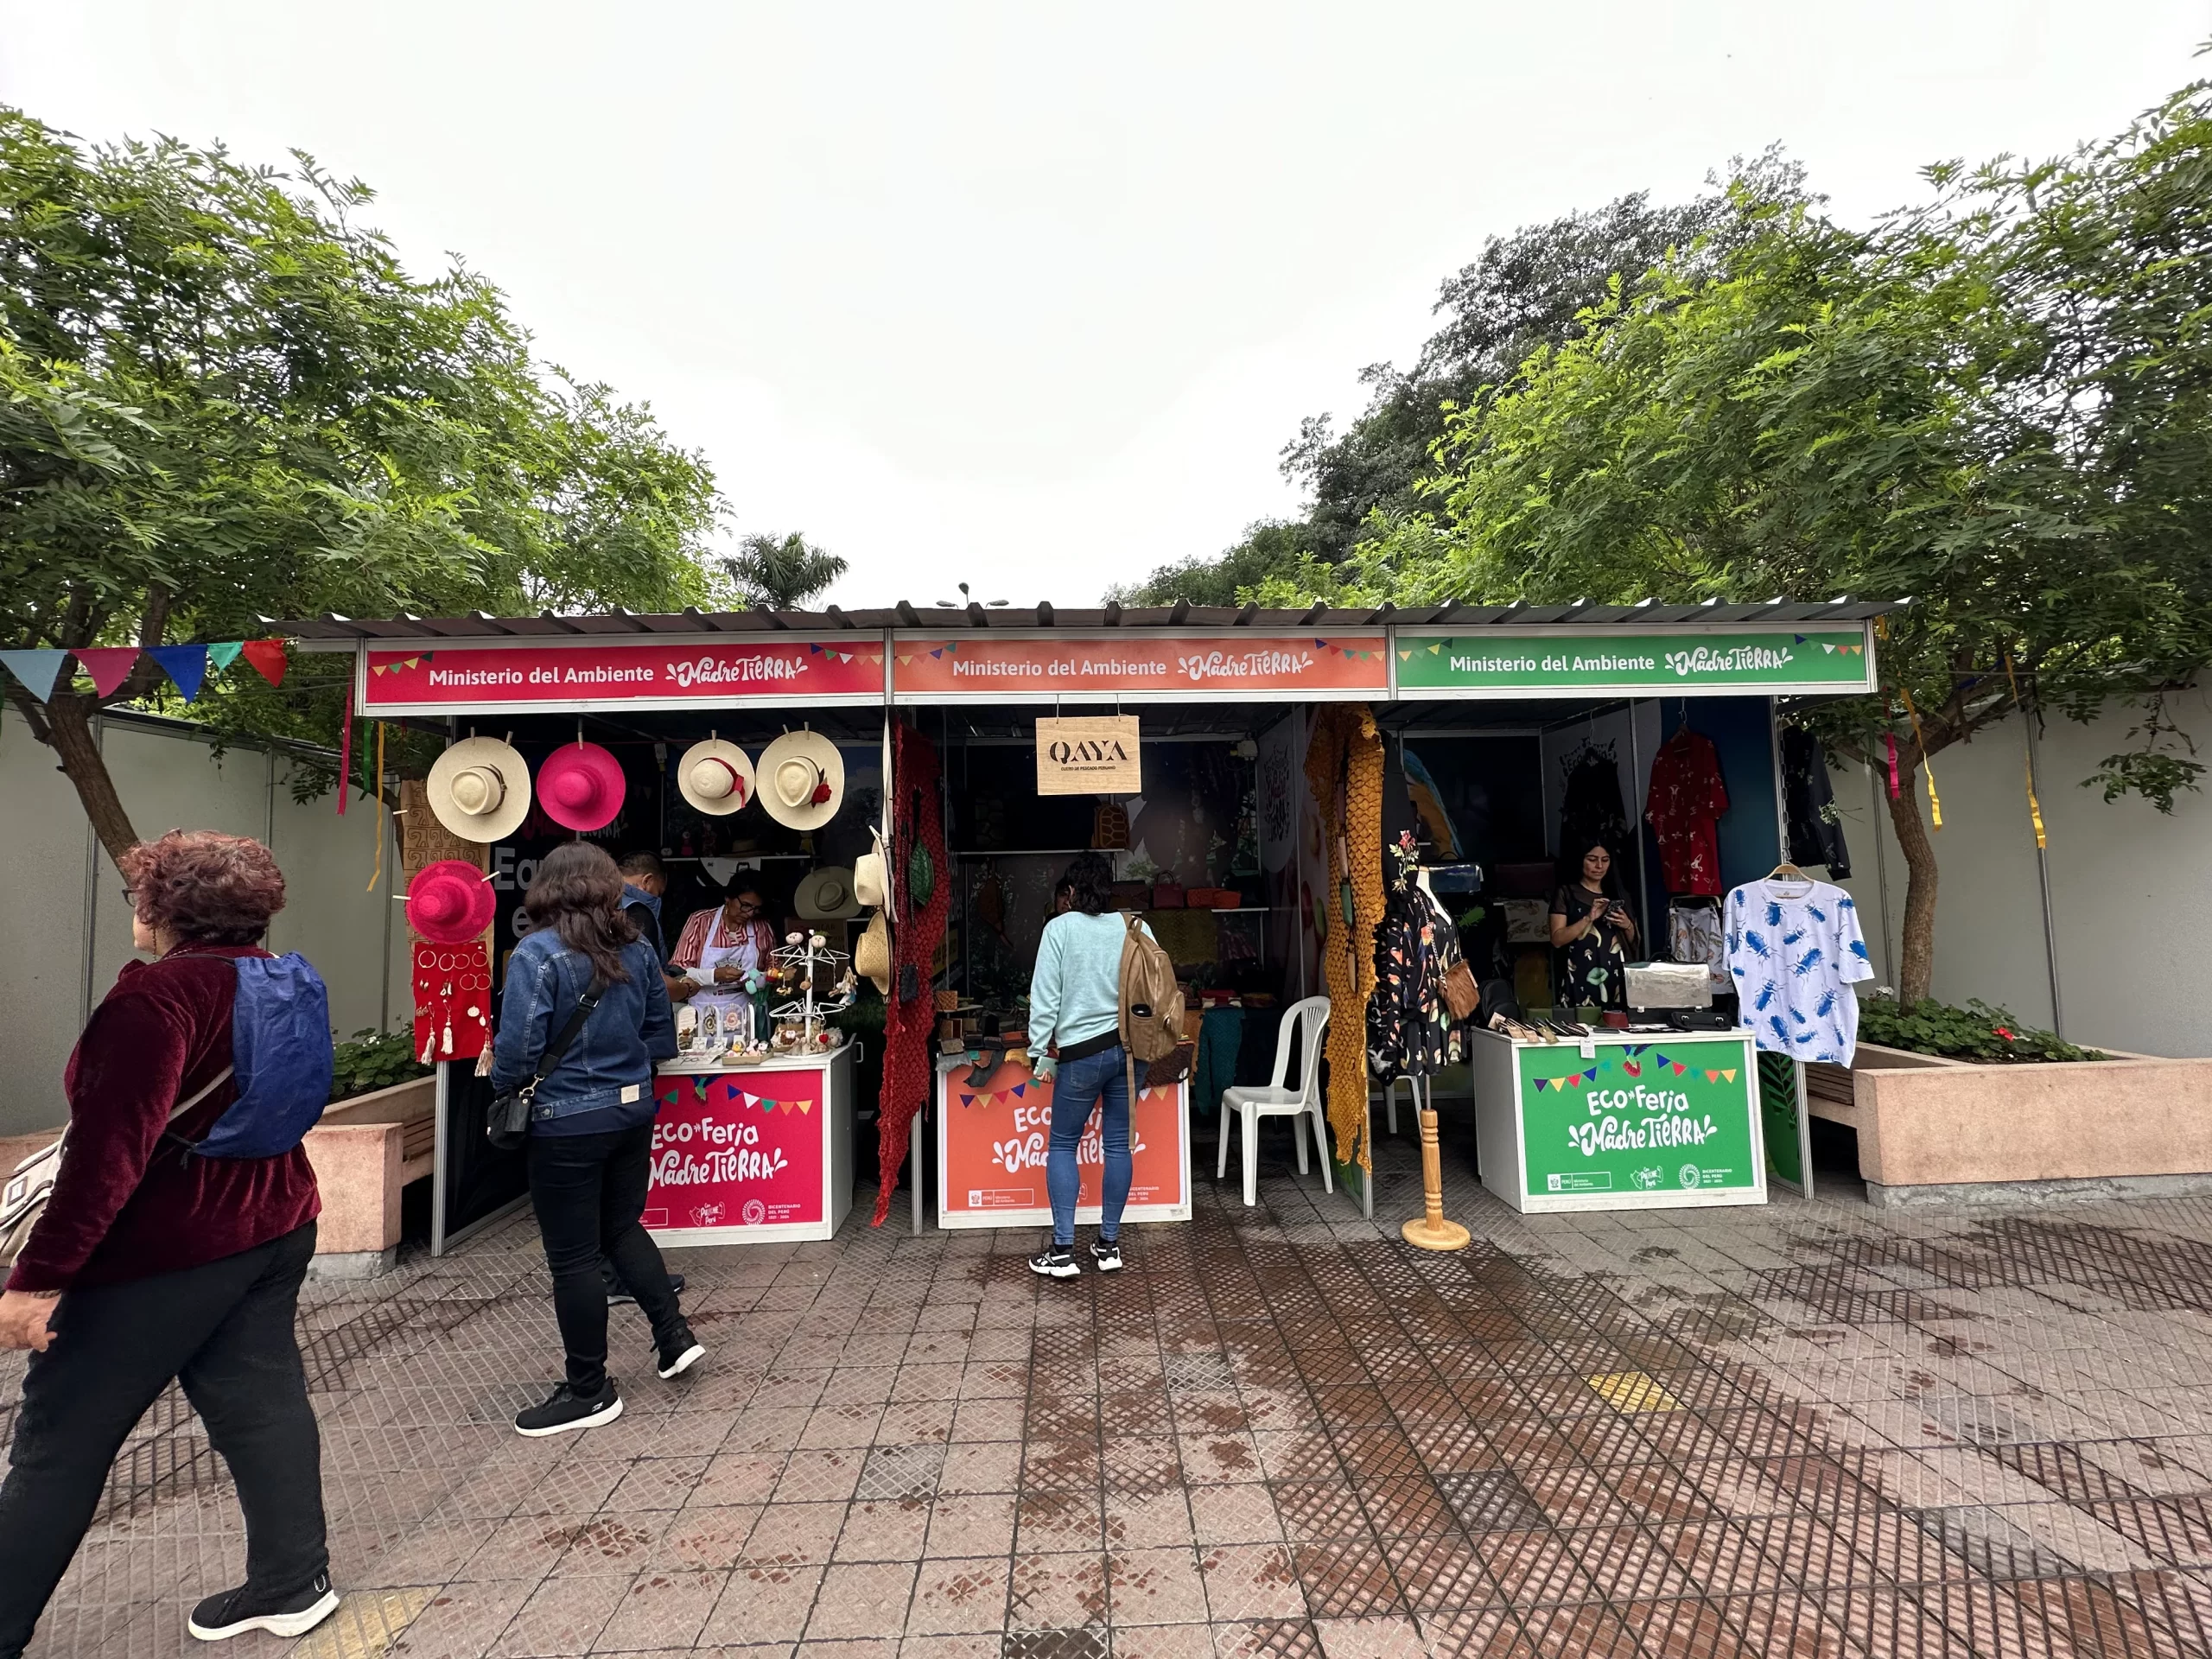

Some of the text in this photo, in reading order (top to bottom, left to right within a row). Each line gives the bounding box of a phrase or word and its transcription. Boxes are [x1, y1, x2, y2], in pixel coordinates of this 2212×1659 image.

[429, 665, 654, 686] Ministerio del Ambiente
[677, 657, 739, 687] Madre
[954, 658, 1166, 677] Ministerio del Ambiente
[1188, 651, 1248, 680] Madre
[1451, 654, 1655, 672] Ministerio del Ambiente
[1675, 647, 1732, 676] Madre
[1049, 740, 1128, 765] QAYA
[1635, 1084, 1689, 1113] Feria
[702, 1116, 759, 1147] Feria
[1580, 1116, 1646, 1156] Madre
